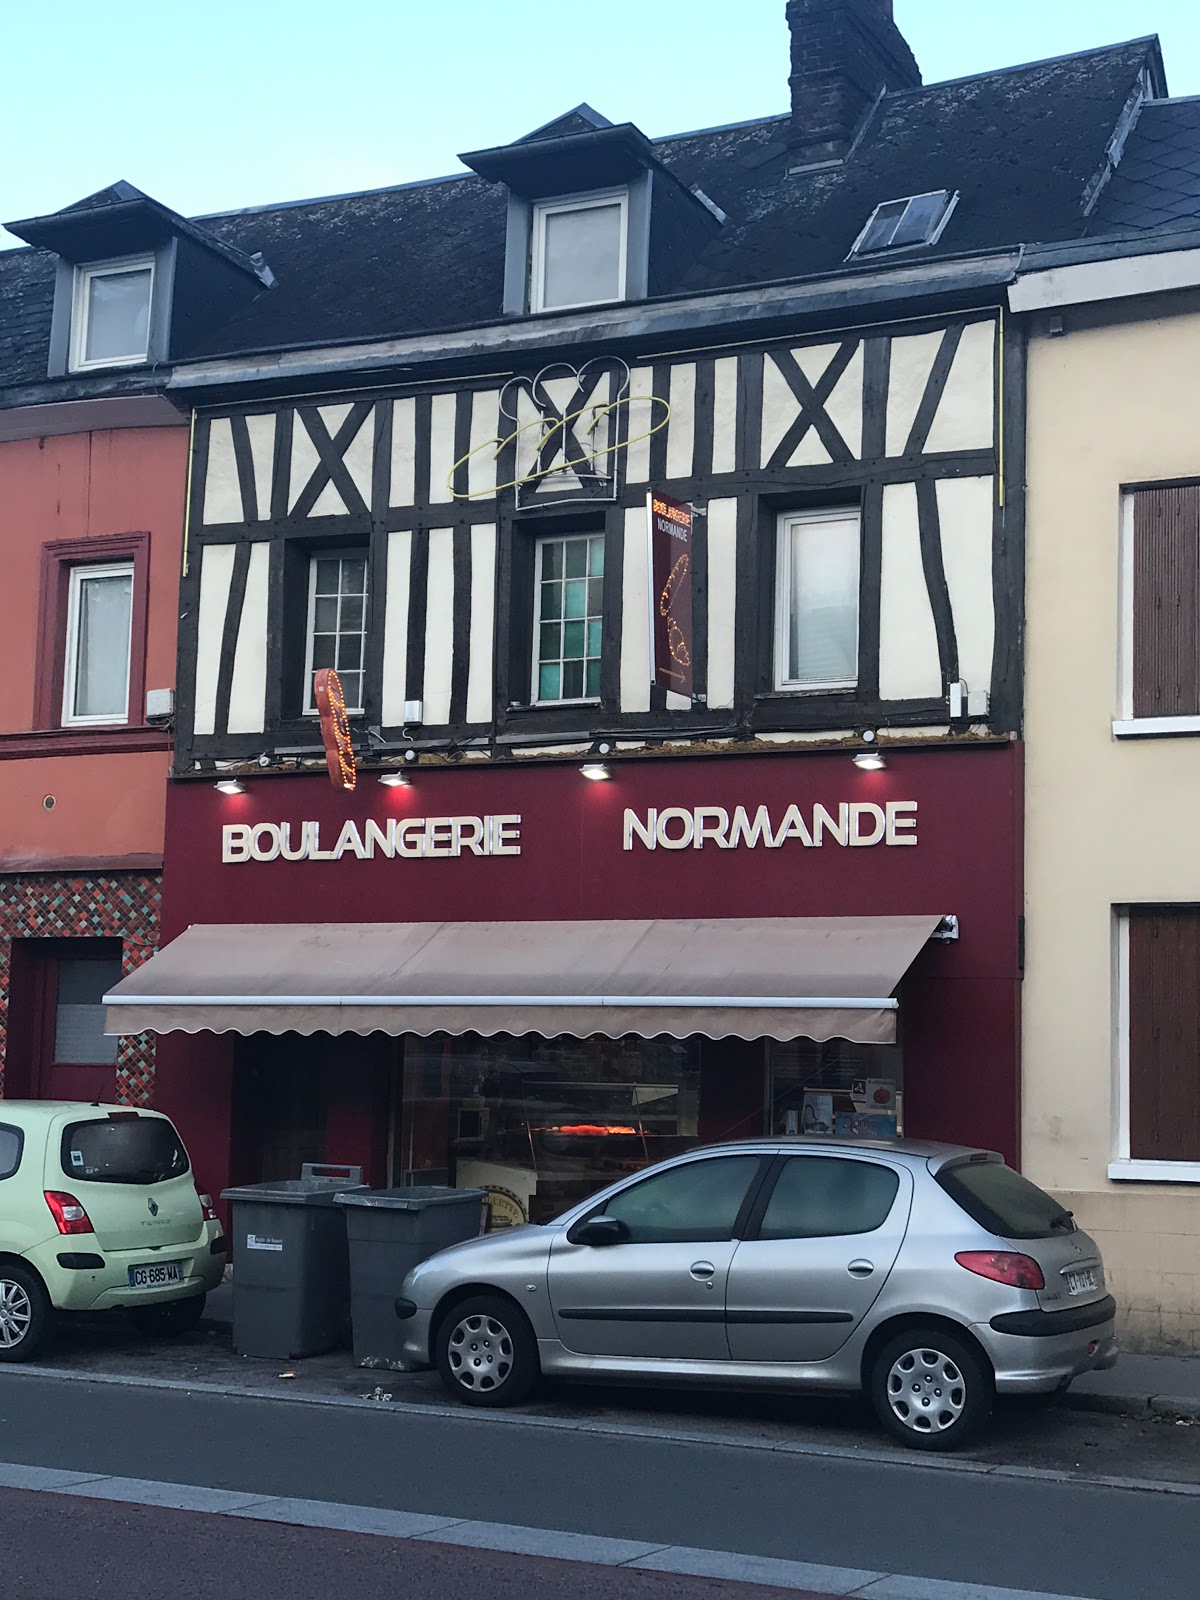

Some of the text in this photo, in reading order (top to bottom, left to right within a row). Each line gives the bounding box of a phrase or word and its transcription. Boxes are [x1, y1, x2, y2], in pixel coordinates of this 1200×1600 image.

[657, 517, 688, 542] NORMANDE
[222, 801, 918, 863] BOULANGERIE NORMANDE
